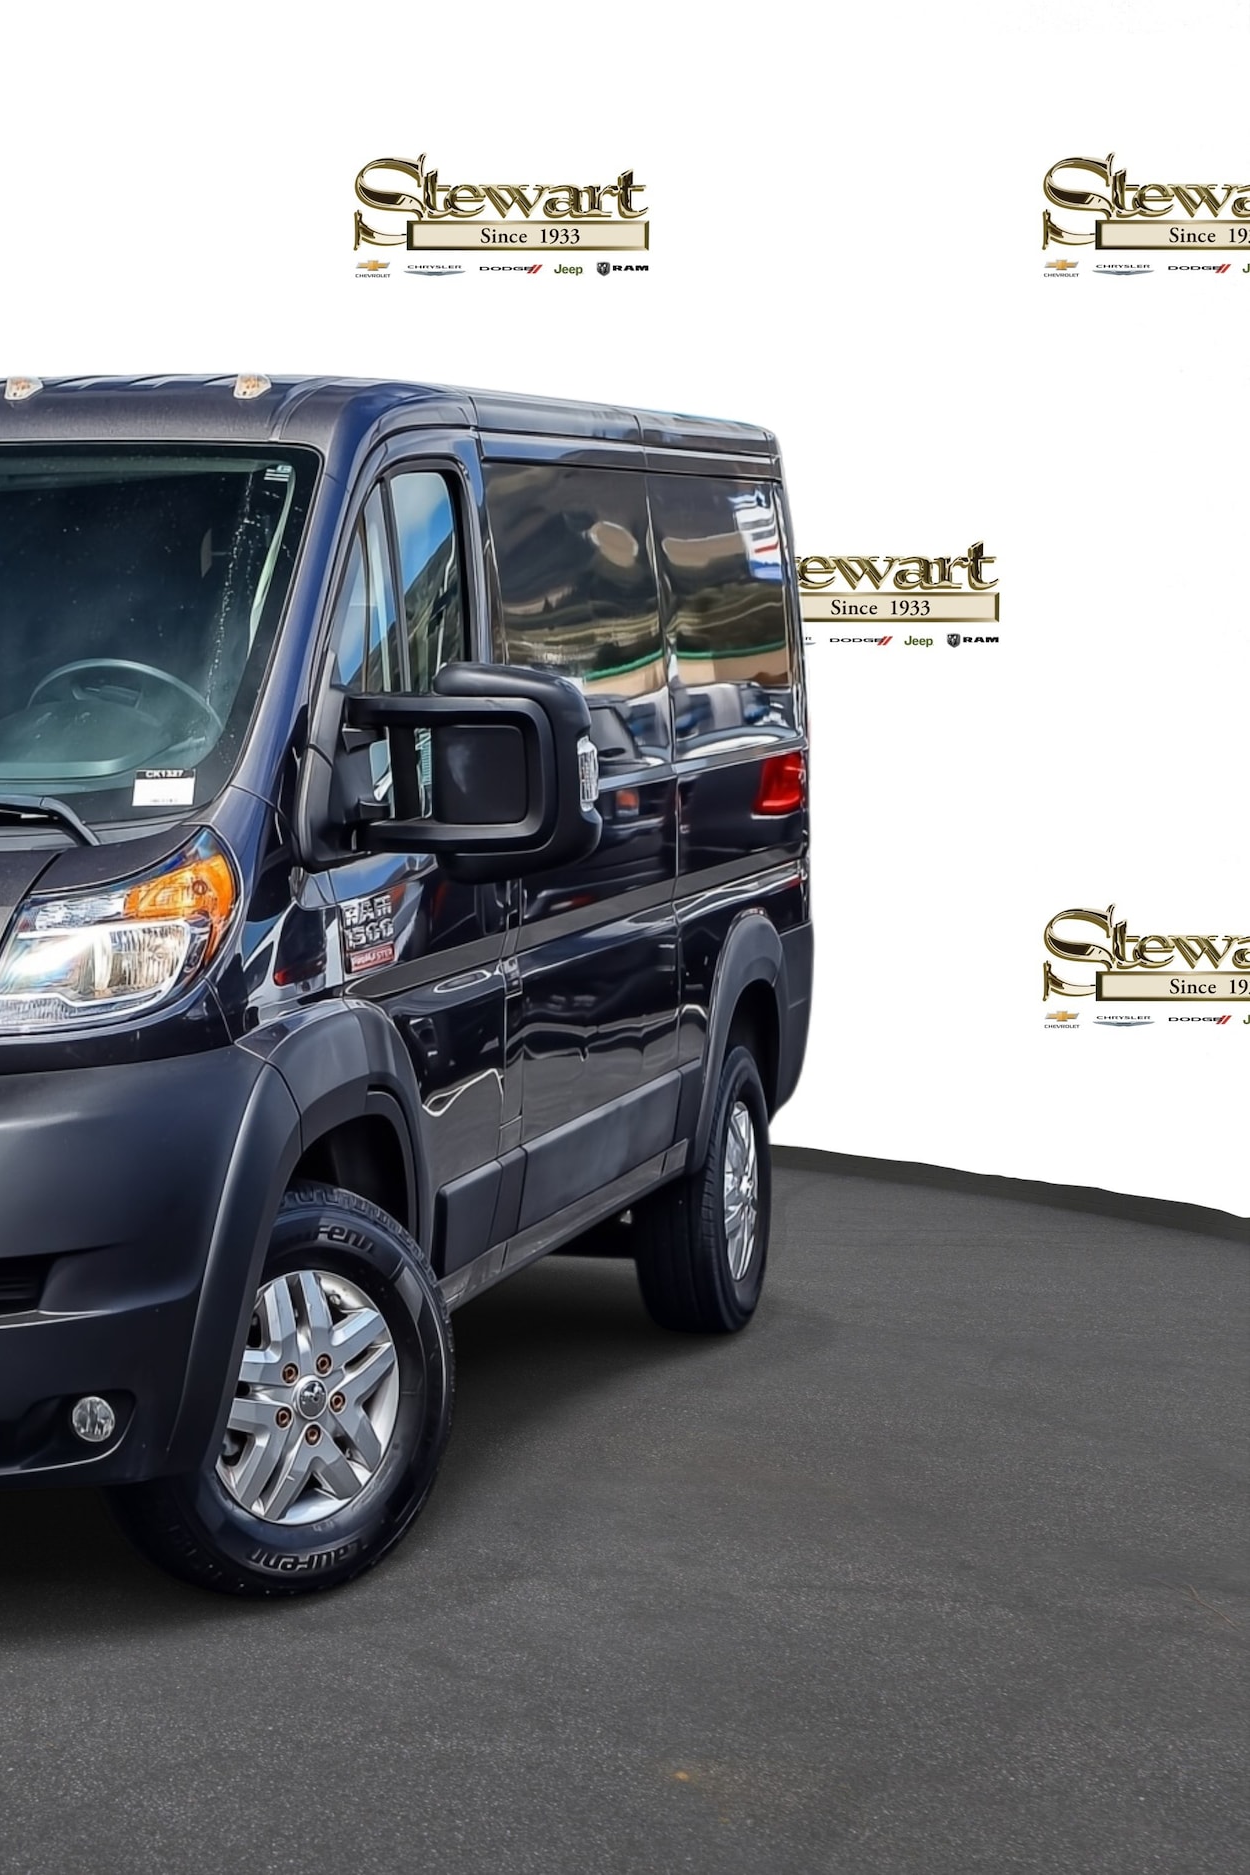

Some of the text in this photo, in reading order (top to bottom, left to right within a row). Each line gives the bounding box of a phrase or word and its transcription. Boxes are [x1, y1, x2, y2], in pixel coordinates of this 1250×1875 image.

[354, 152, 650, 250] Stewart
[1042, 153, 1250, 251] Stew
[480, 227, 581, 244] Since 1933
[1169, 227, 1250, 246] Since 19
[554, 263, 584, 276] Jeep
[612, 264, 650, 272] RAM
[794, 540, 999, 590] ewart
[830, 599, 931, 616] Since 1933
[904, 635, 934, 648] Jeep
[962, 636, 1000, 644] RAM
[1042, 904, 1250, 1002] Stew
[1169, 978, 1250, 997] Since 19
